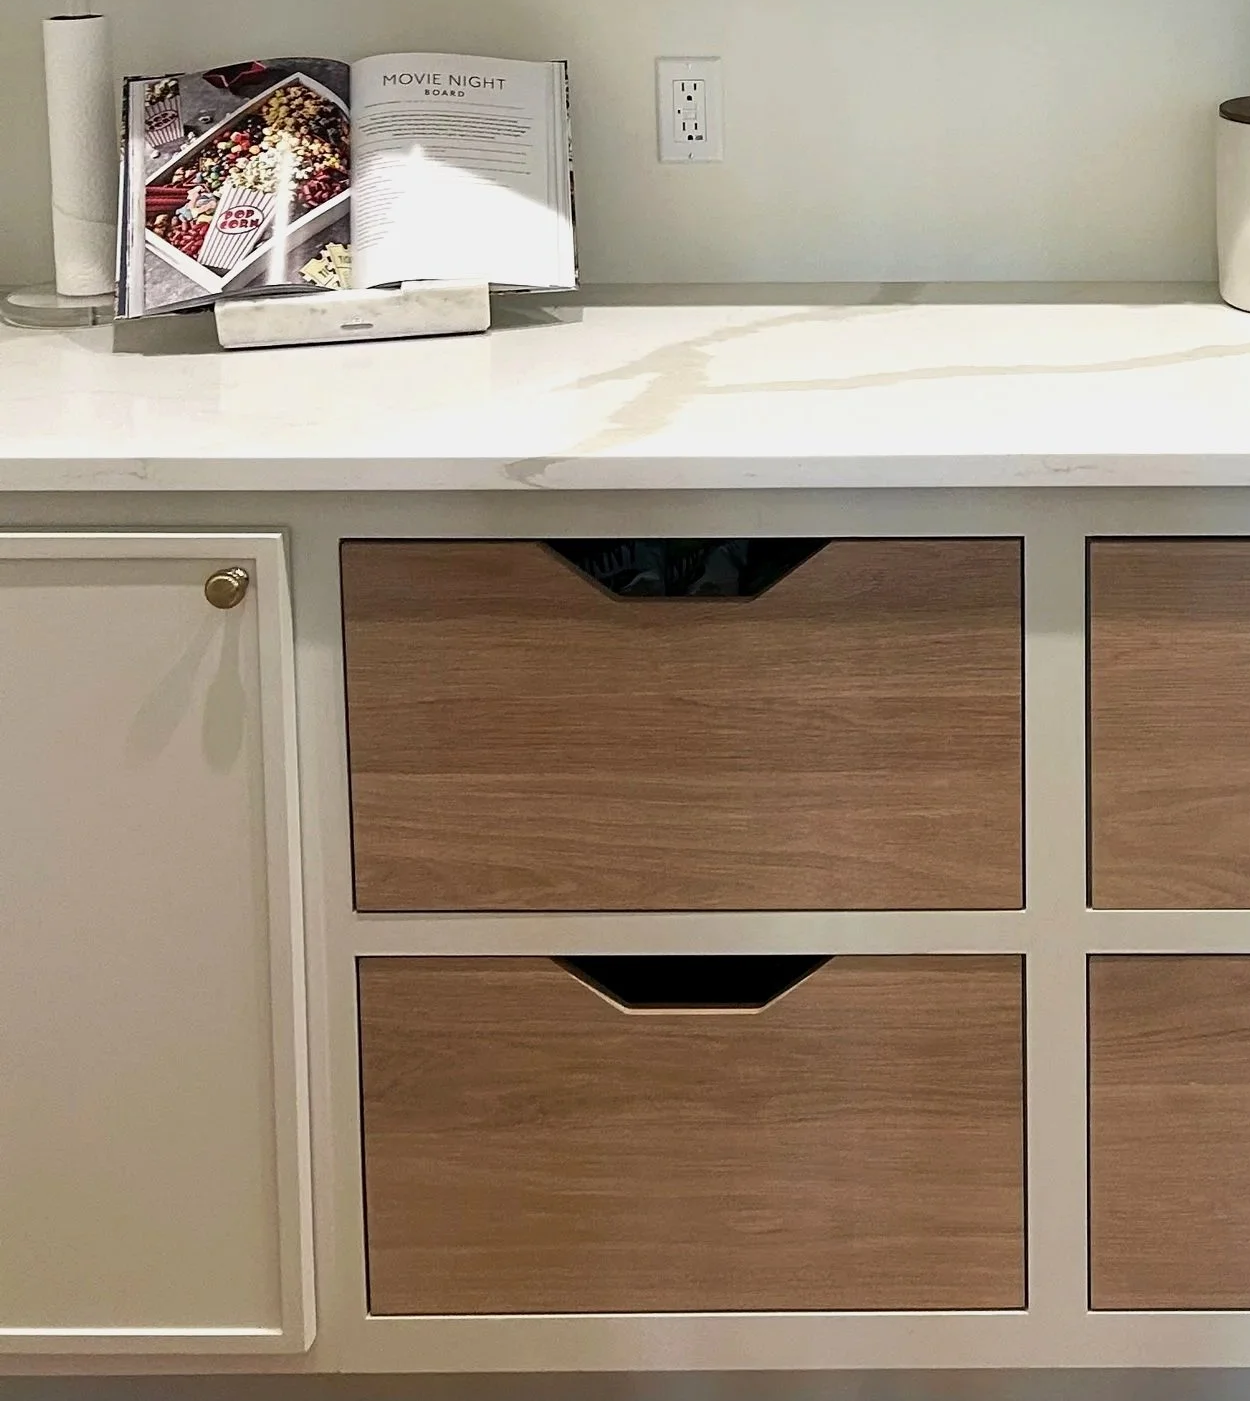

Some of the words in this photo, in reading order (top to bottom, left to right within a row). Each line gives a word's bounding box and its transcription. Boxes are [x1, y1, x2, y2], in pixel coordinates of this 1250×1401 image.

[382, 73, 441, 87] MOVIE
[449, 74, 507, 90] NIGHT
[424, 88, 465, 98] BOARD
[224, 209, 255, 220] POP
[219, 219, 260, 230] CORN
